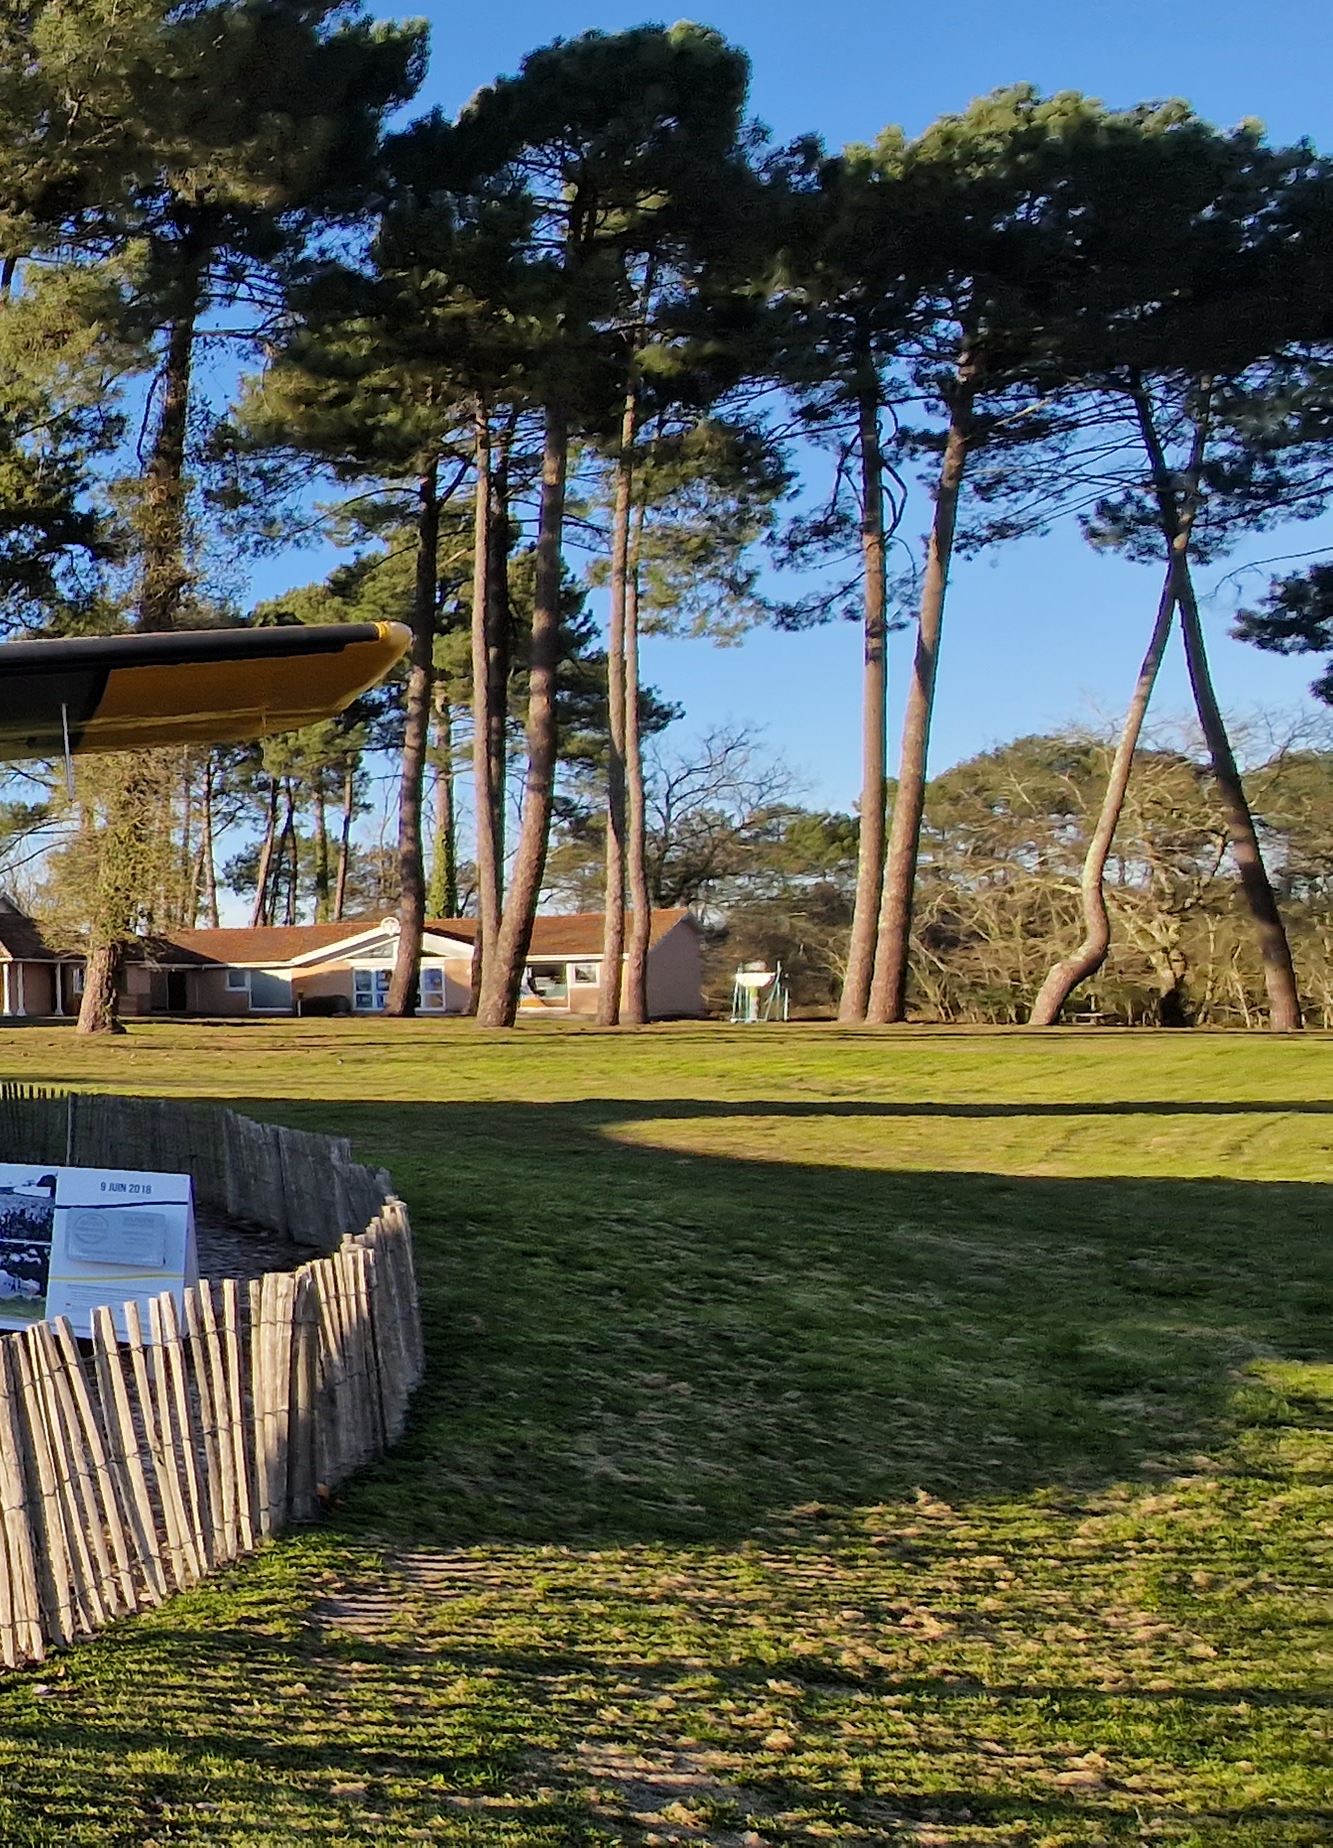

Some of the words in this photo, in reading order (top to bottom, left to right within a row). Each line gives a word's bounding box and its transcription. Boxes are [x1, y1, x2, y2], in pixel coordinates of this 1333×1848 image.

[100, 1181, 107, 1192] 9
[108, 1182, 127, 1193] JUIN
[128, 1183, 152, 1195] 2018
